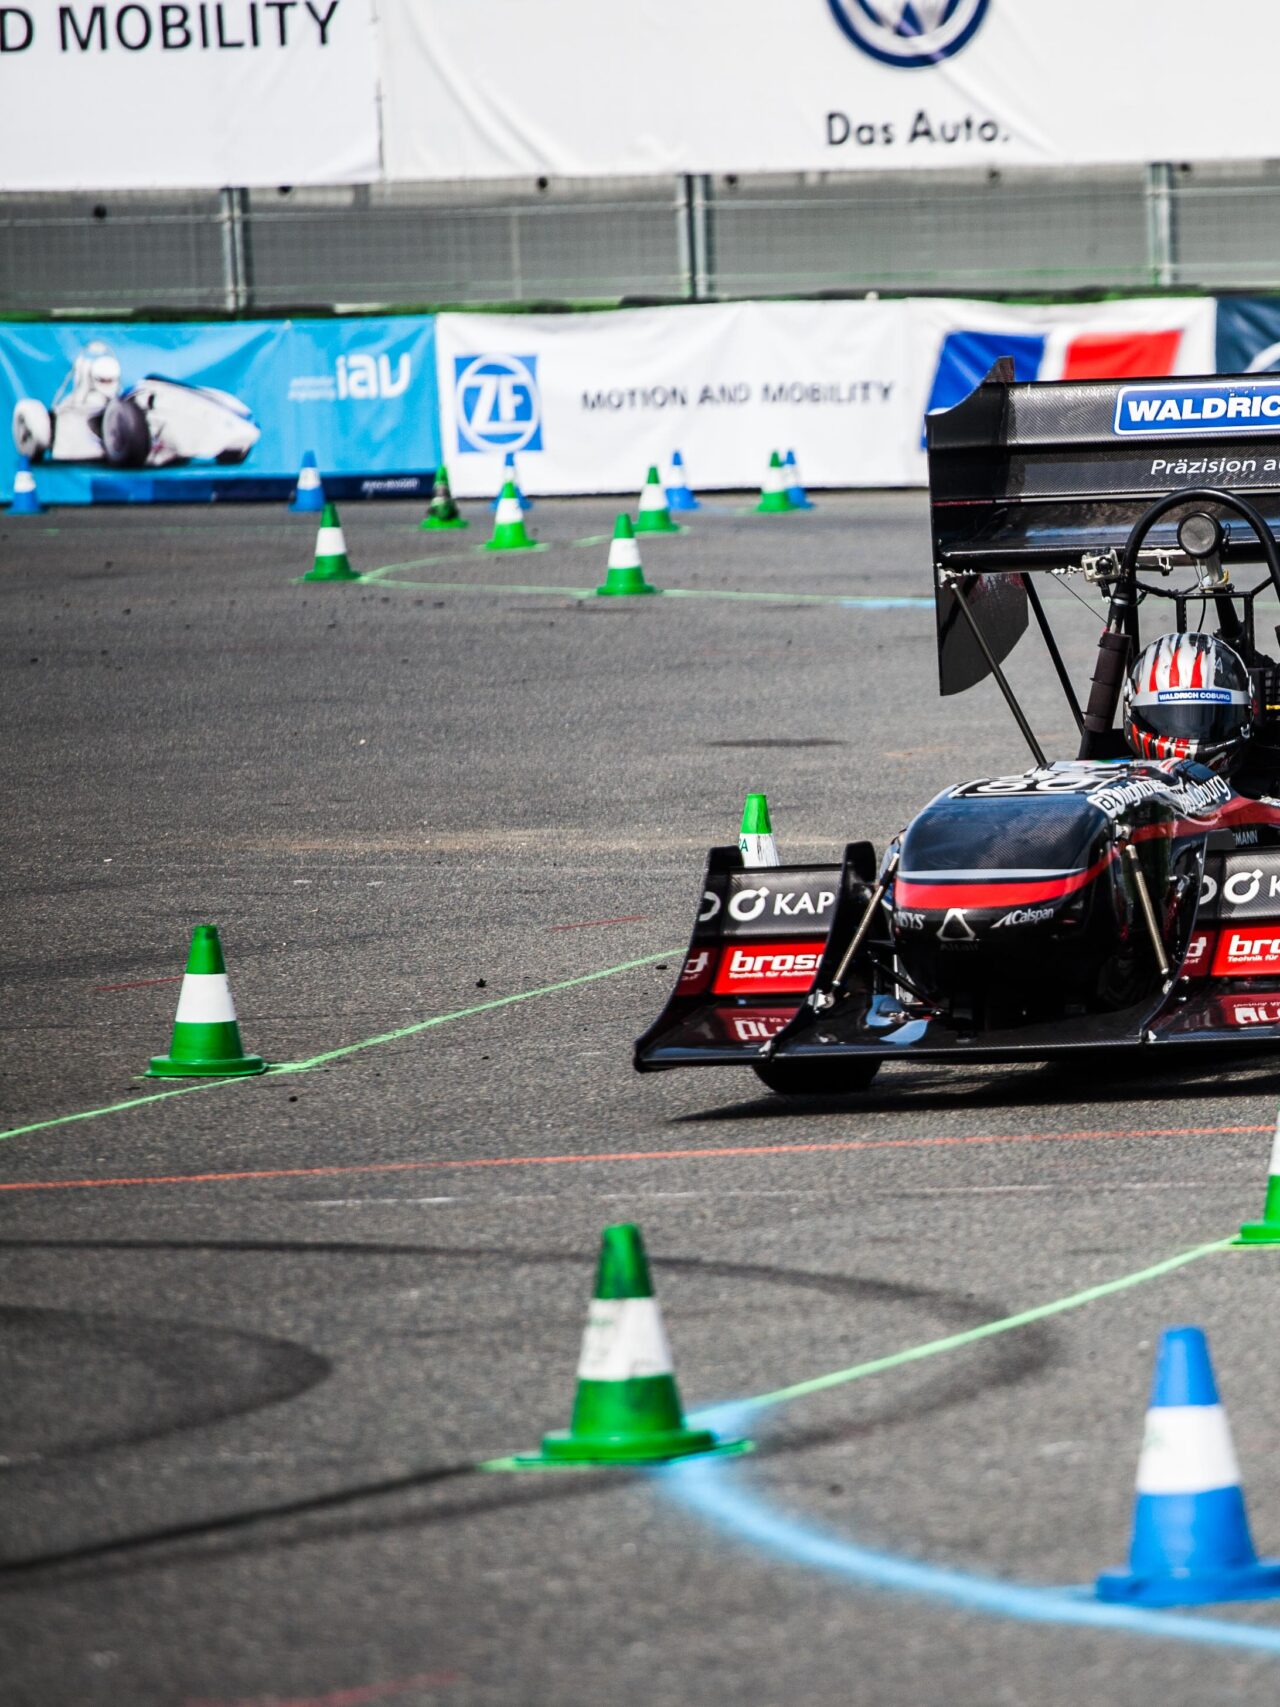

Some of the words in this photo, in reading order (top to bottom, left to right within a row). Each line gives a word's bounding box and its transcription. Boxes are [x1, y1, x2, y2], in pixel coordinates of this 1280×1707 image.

[58, 1, 339, 51] MOBILITY
[826, 111, 895, 146] Das
[908, 108, 1010, 144] Auto.
[335, 352, 411, 400] iav
[582, 386, 687, 410] MOTION
[698, 383, 751, 405] AND
[762, 380, 895, 405] MOBILITY
[1150, 456, 1256, 476] Präzision
[1158, 691, 1199, 701] WALDRICH
[1200, 692, 1231, 701] COBURG
[1011, 908, 1055, 925] Calspan
[730, 950, 824, 972] bros
[1228, 955, 1263, 963] Technik
[1265, 953, 1279, 961] für
